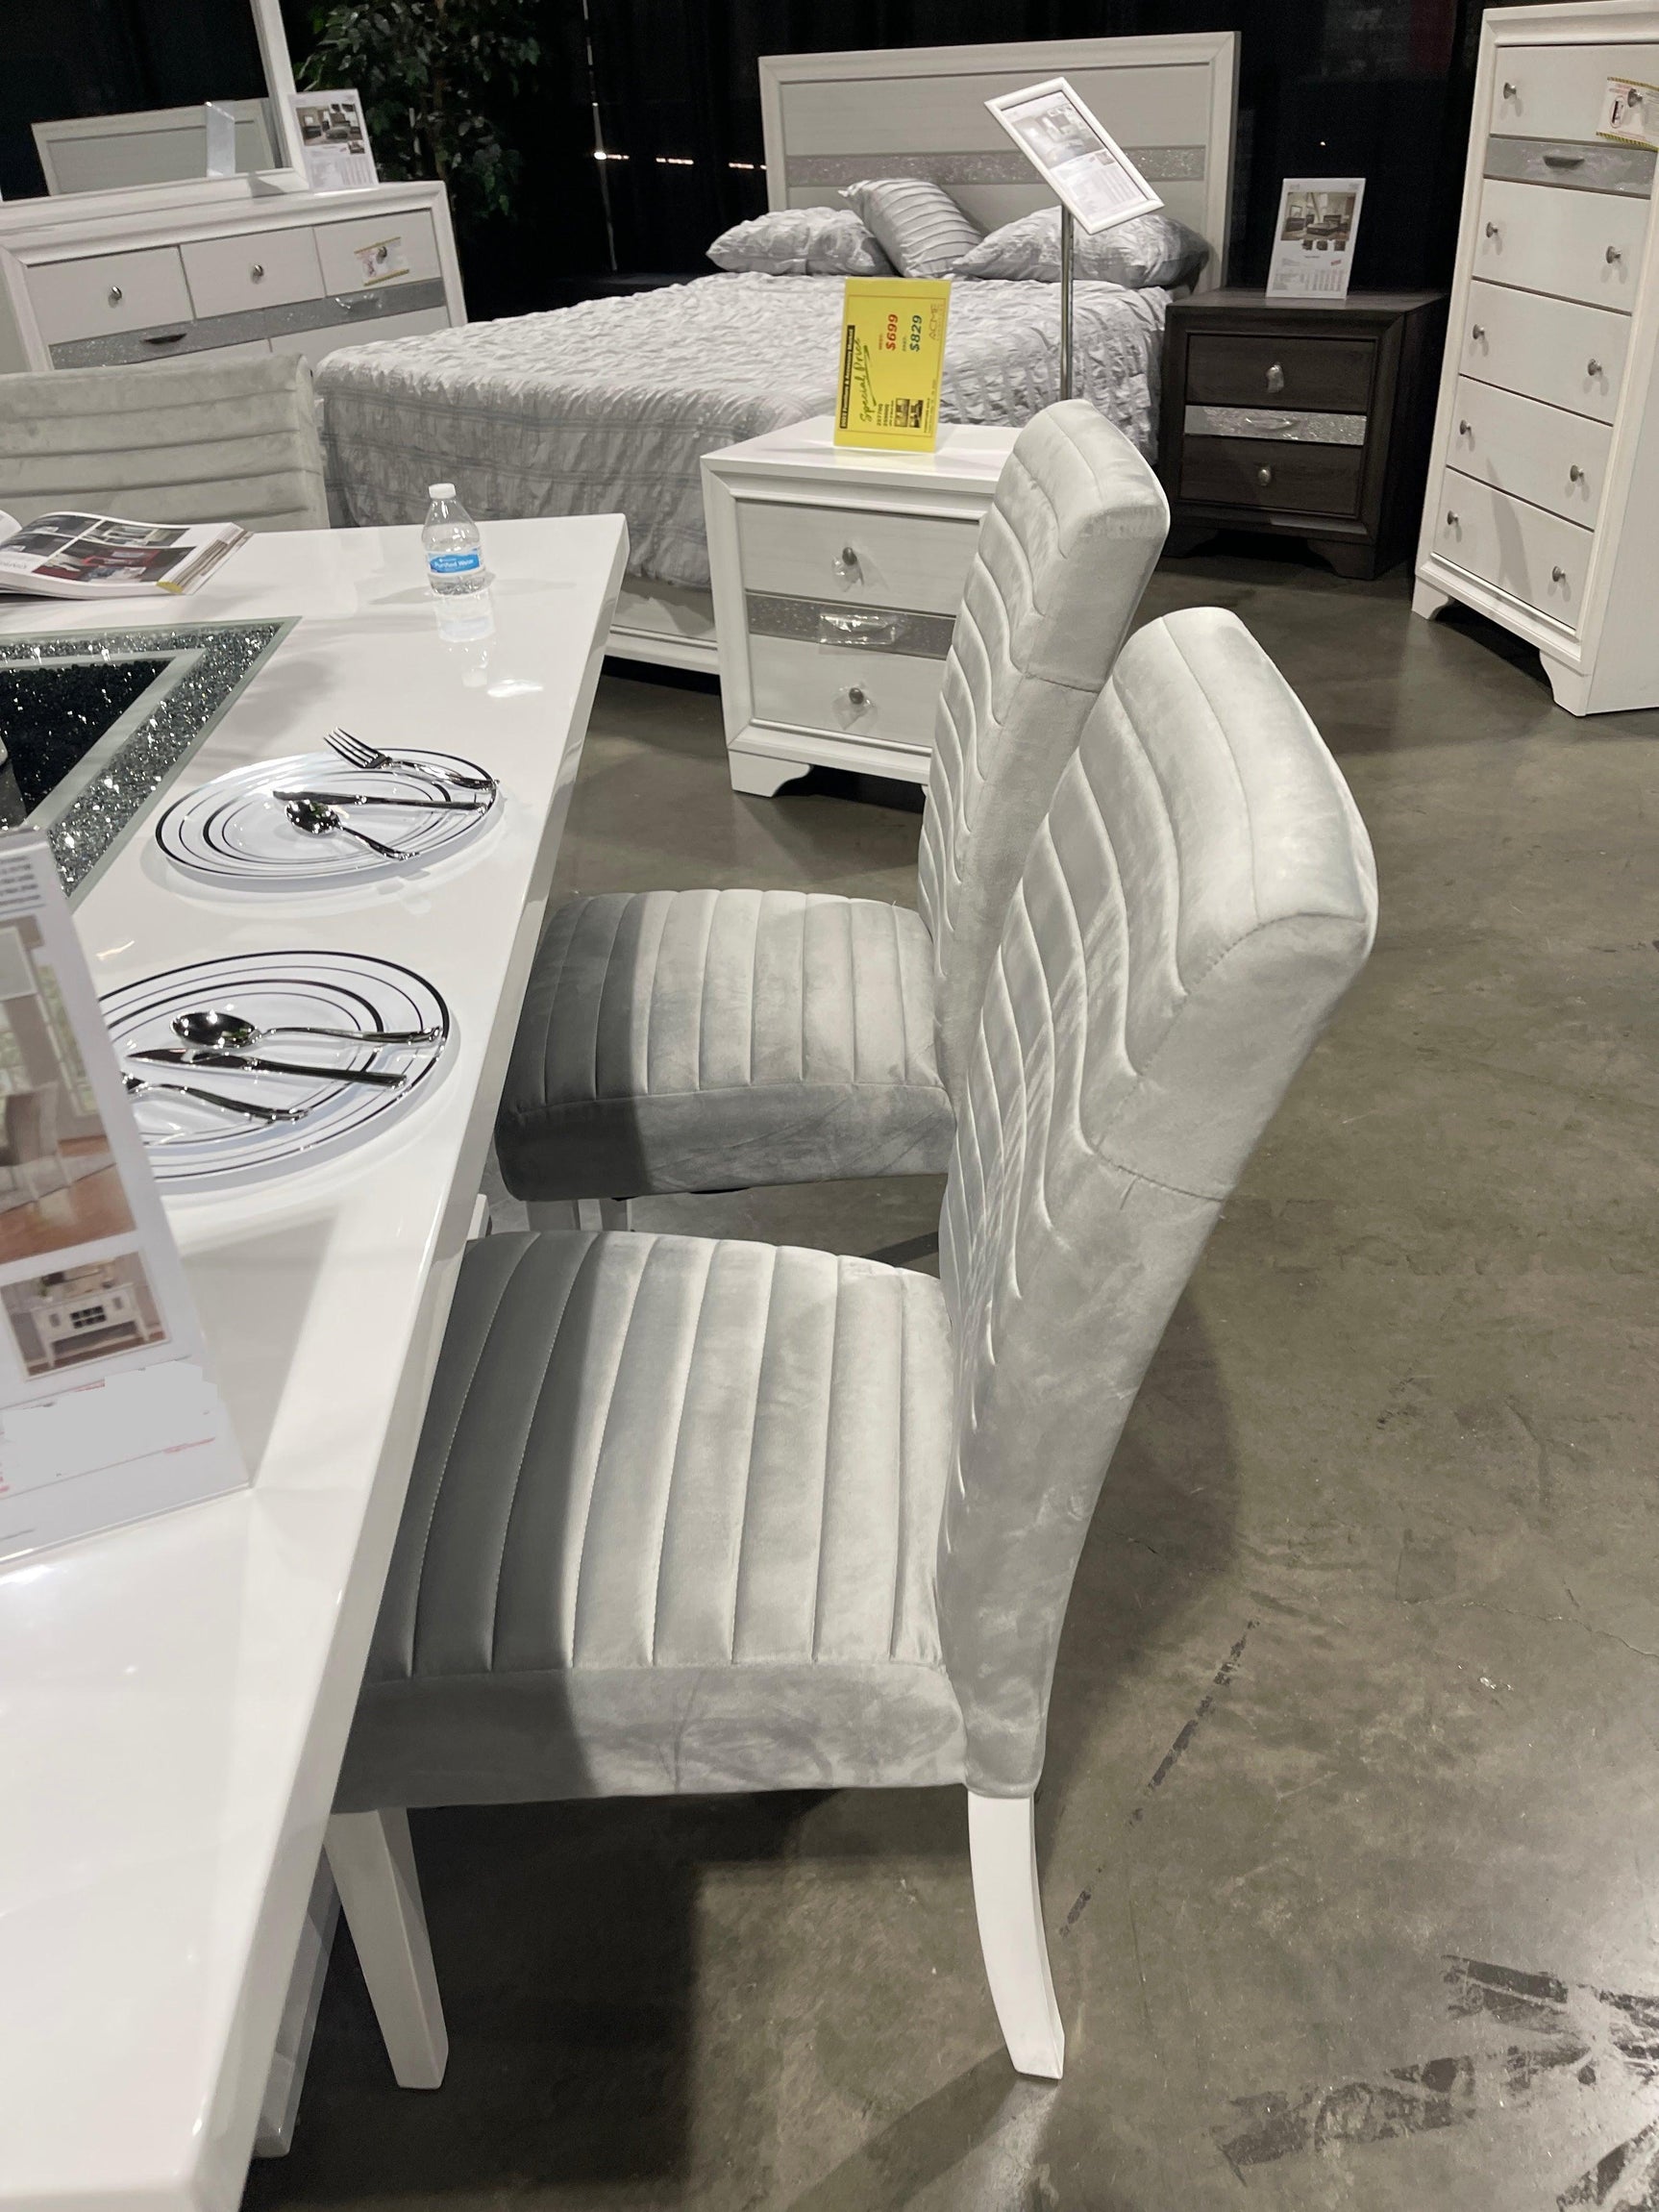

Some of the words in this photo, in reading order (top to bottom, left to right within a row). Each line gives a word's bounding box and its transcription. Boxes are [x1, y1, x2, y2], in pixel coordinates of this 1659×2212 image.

[885, 313, 899, 351] $699
[909, 314, 923, 352] $829
[929, 303, 938, 340] ACME
[853, 337, 864, 372] Price
[854, 375, 874, 422] Special
